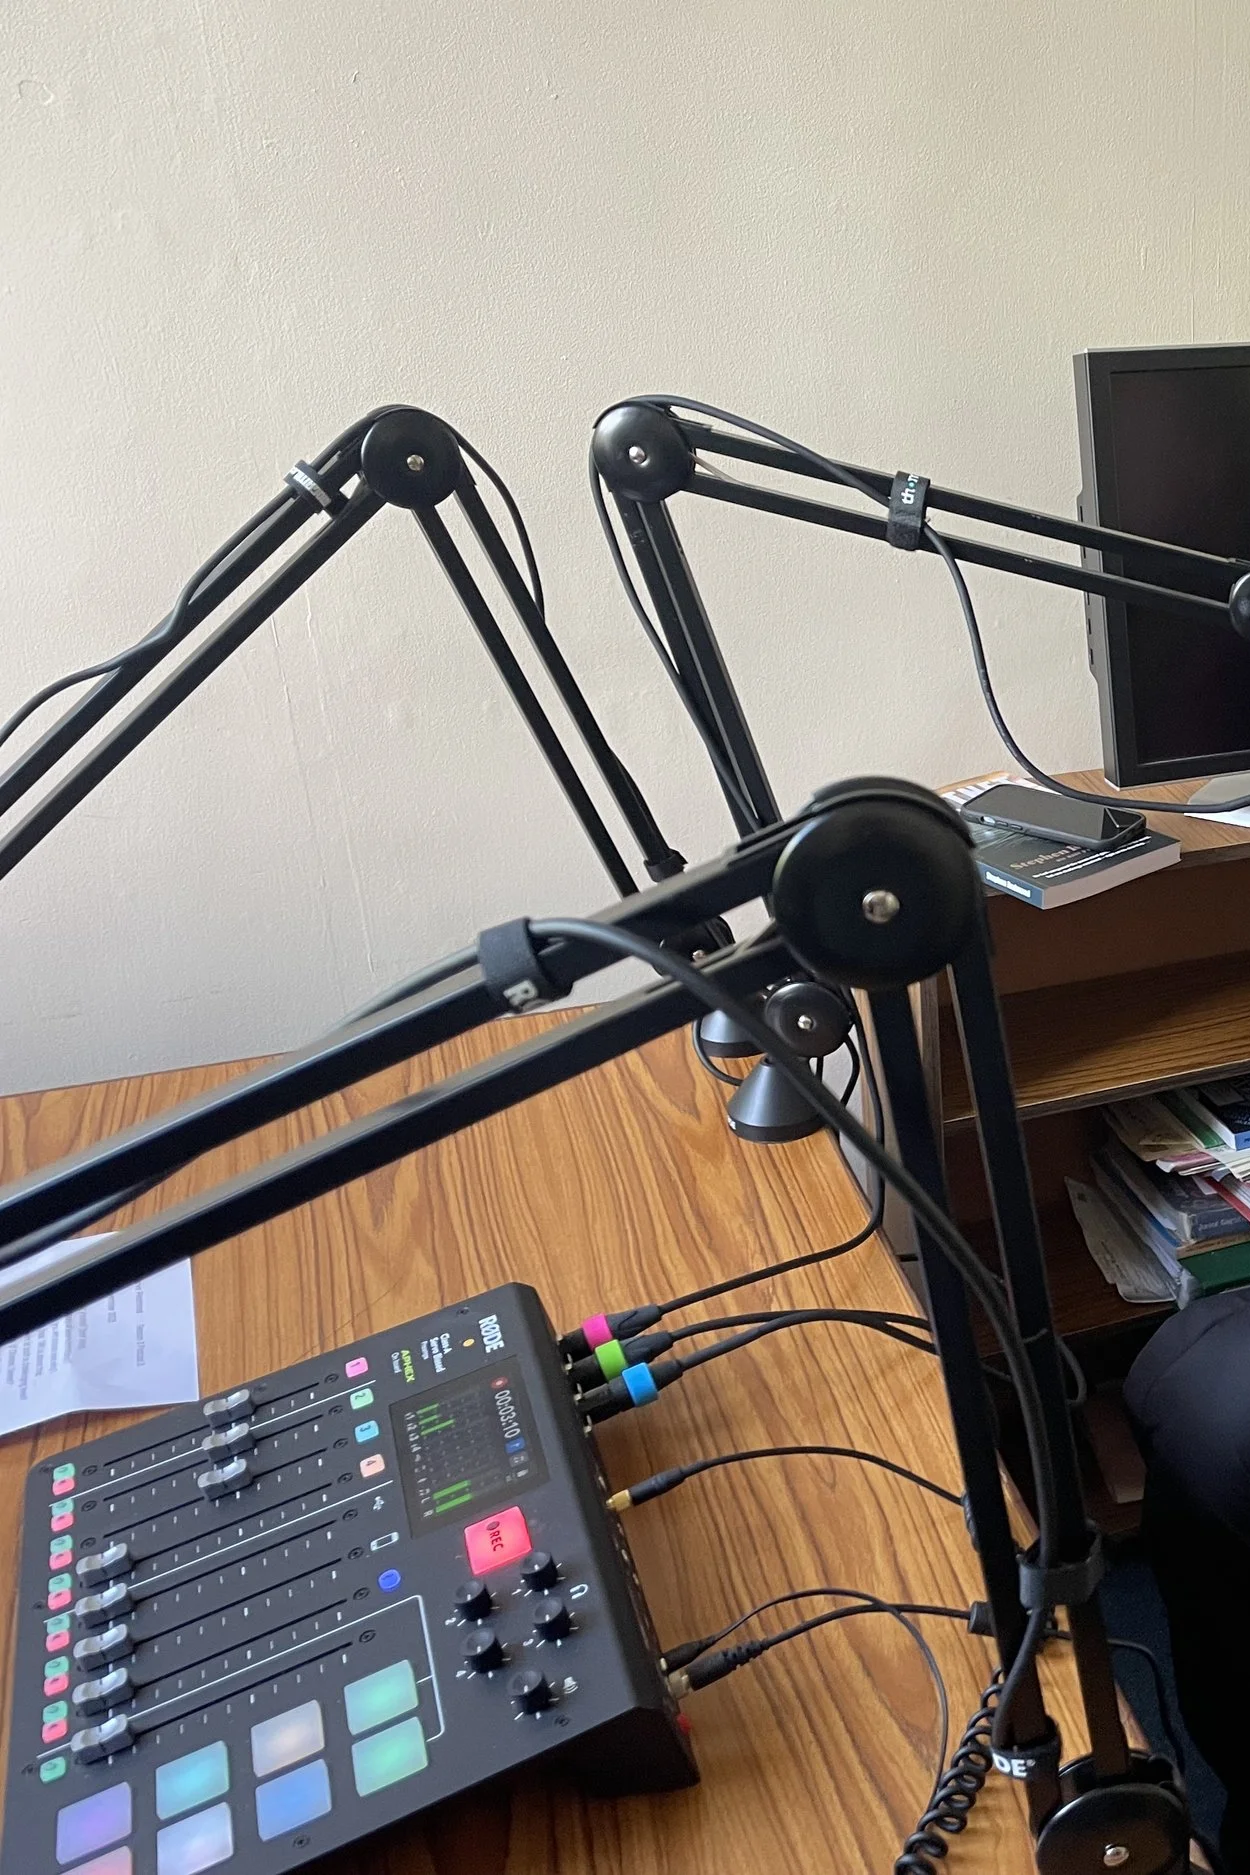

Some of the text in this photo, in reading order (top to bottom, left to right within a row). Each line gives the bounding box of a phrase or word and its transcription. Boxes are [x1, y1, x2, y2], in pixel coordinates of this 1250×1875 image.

[1009, 846, 1069, 871] Stephen
[401, 1350, 415, 1383] APHEX
[494, 1389, 521, 1439] 00:03:10
[489, 1529, 504, 1552] REC
